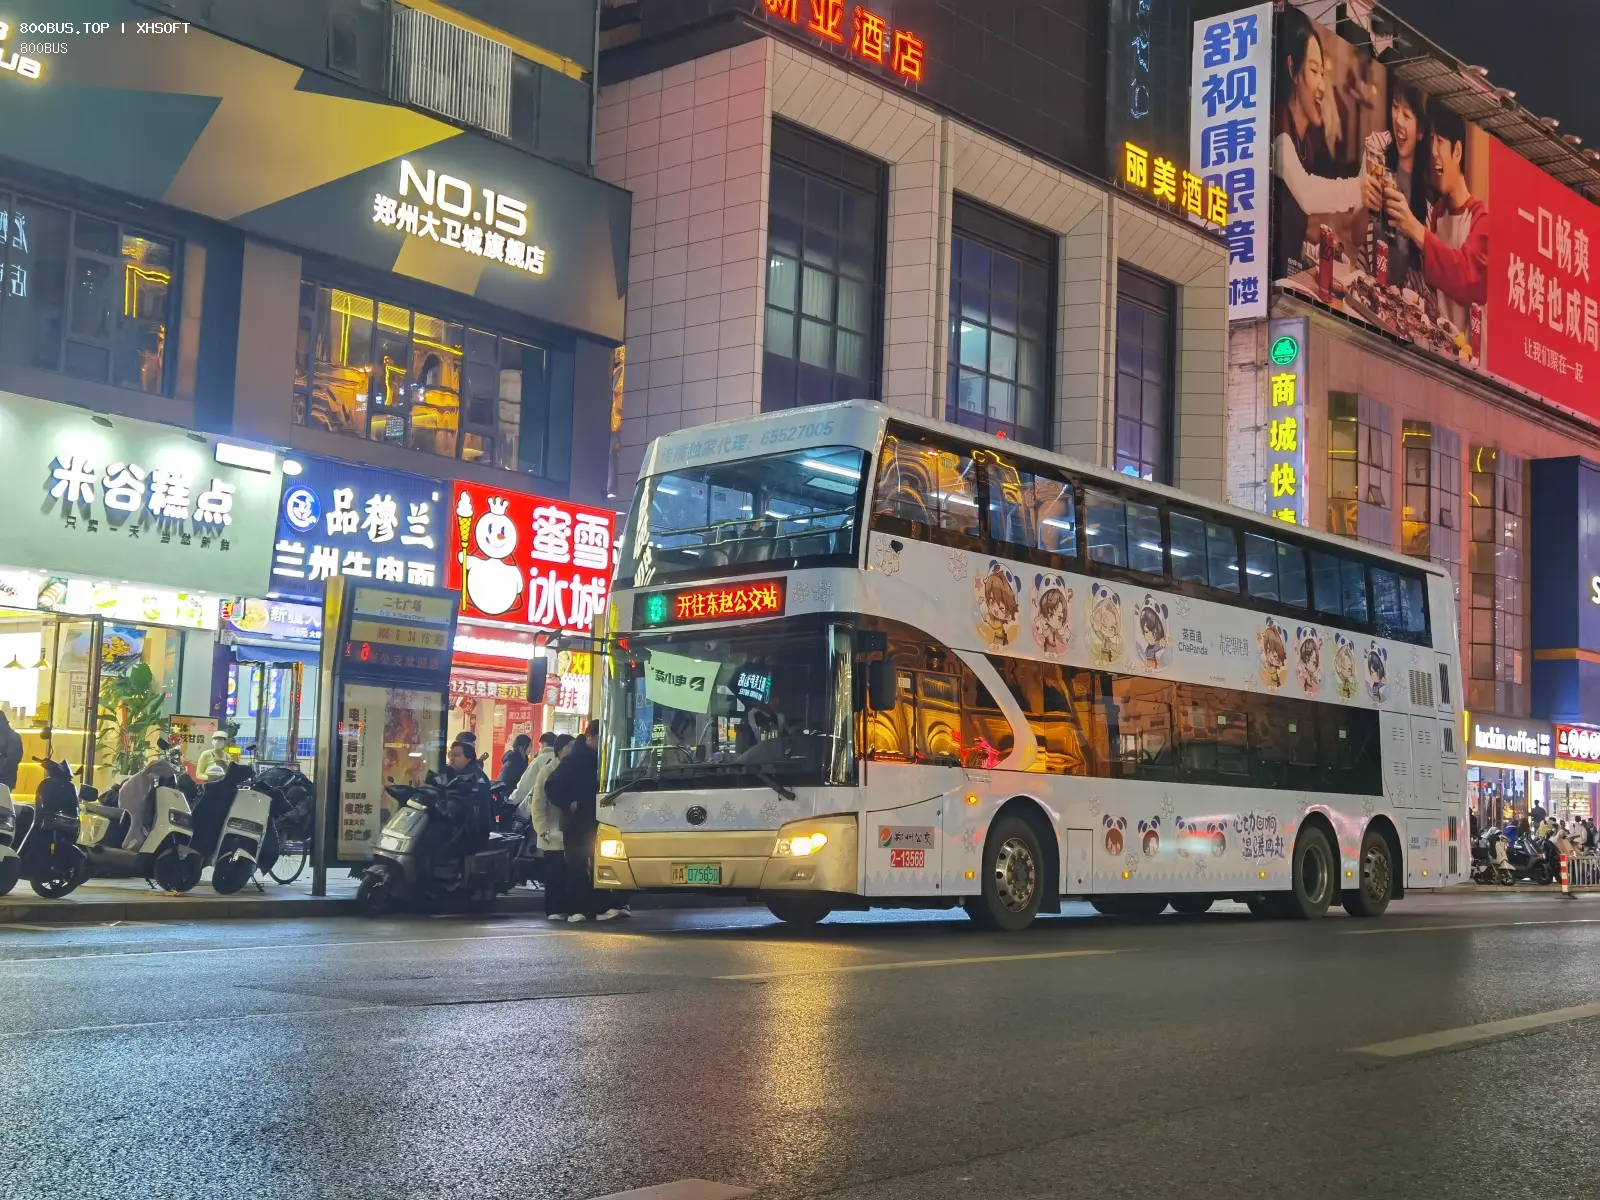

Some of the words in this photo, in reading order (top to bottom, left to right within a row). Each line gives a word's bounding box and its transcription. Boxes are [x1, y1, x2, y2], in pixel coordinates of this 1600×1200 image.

[398, 159, 528, 236] NO.15
[1125, 141, 1229, 227] 丽美酒店
[372, 193, 546, 275] 郑州大卫城旗舰店
[1517, 205, 1590, 284] 一口畅爽
[1507, 252, 1600, 352] 烧烤也成局
[1523, 336, 1583, 383] 让我们聚在一起
[760, 420, 835, 446] 65527005
[52, 455, 237, 526] 米谷糕点
[325, 487, 435, 549] 品穆兰
[530, 505, 610, 570] 蜜雪
[383, 597, 422, 612] 二七广场
[528, 566, 606, 630] 冰城
[676, 585, 778, 618] 开往东赵公交站
[1178, 641, 1208, 656] ChaPanda
[1475, 724, 1506, 751] luckin
[1506, 729, 1537, 755] coffee
[891, 850, 925, 867] 2-13568
